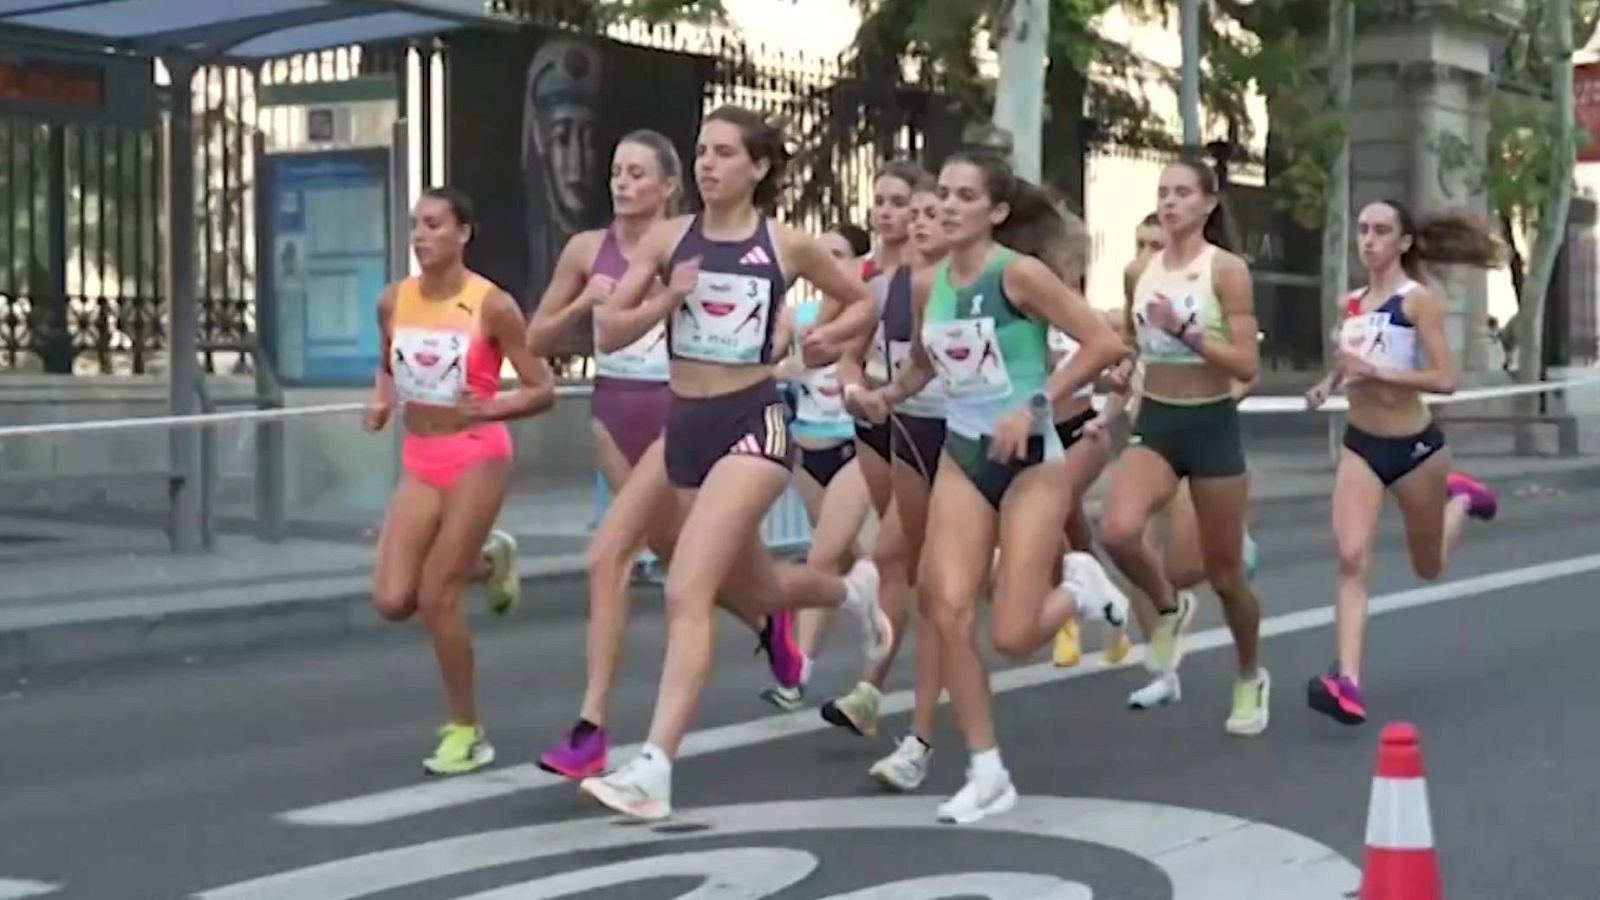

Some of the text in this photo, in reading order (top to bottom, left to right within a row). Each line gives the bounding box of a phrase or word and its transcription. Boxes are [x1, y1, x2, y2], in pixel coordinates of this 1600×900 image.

[746, 280, 758, 298] 3
[1185, 294, 1195, 309] 6
[974, 321, 983, 339] 1
[450, 335, 460, 351] 5
